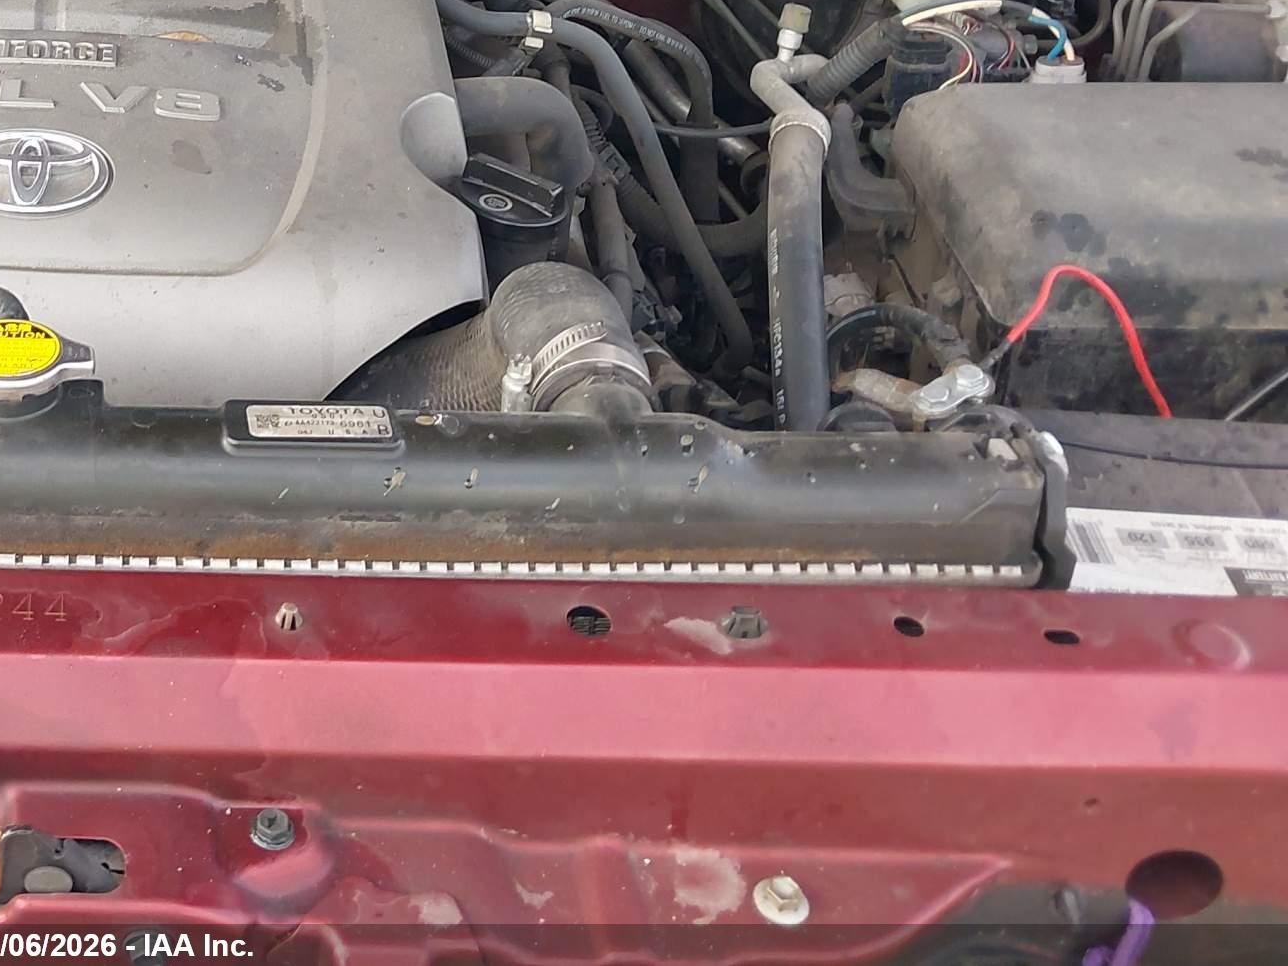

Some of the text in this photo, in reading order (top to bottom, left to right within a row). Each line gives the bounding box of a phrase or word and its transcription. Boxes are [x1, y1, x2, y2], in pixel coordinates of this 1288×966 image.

[79, 81, 221, 122] V8
[288, 407, 365, 415] TOYOTA
[372, 409, 386, 419] U
